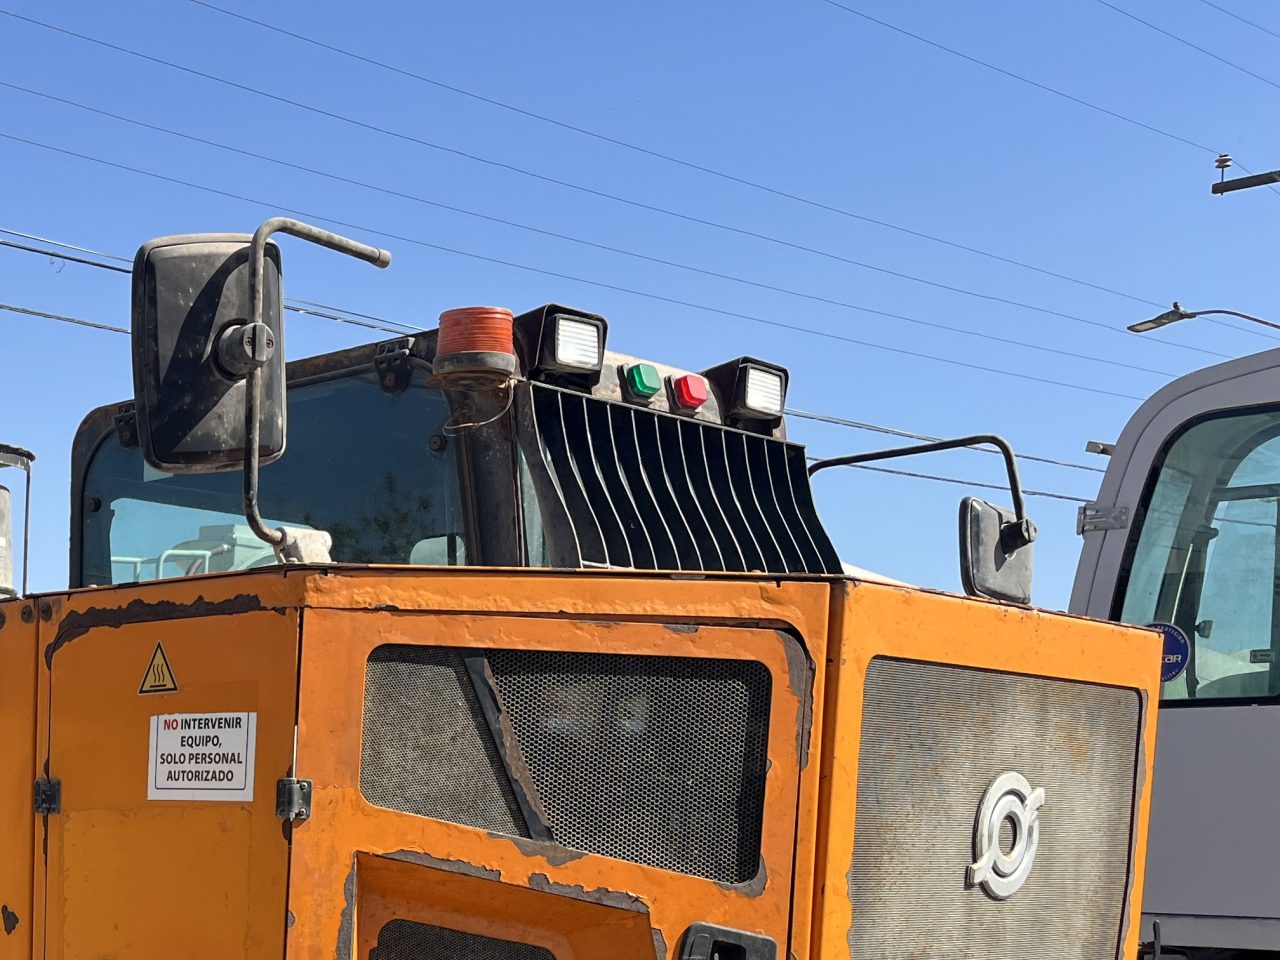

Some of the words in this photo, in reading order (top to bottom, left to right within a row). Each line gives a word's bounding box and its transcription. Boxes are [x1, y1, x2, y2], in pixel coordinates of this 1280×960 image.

[163, 718, 179, 731] NO
[180, 716, 242, 730] INTERVENIR
[180, 735, 222, 748] EQUIPO,
[159, 752, 186, 764] SOLO
[188, 752, 243, 764] PERSONAL
[166, 769, 234, 781] AUTORIZADO
